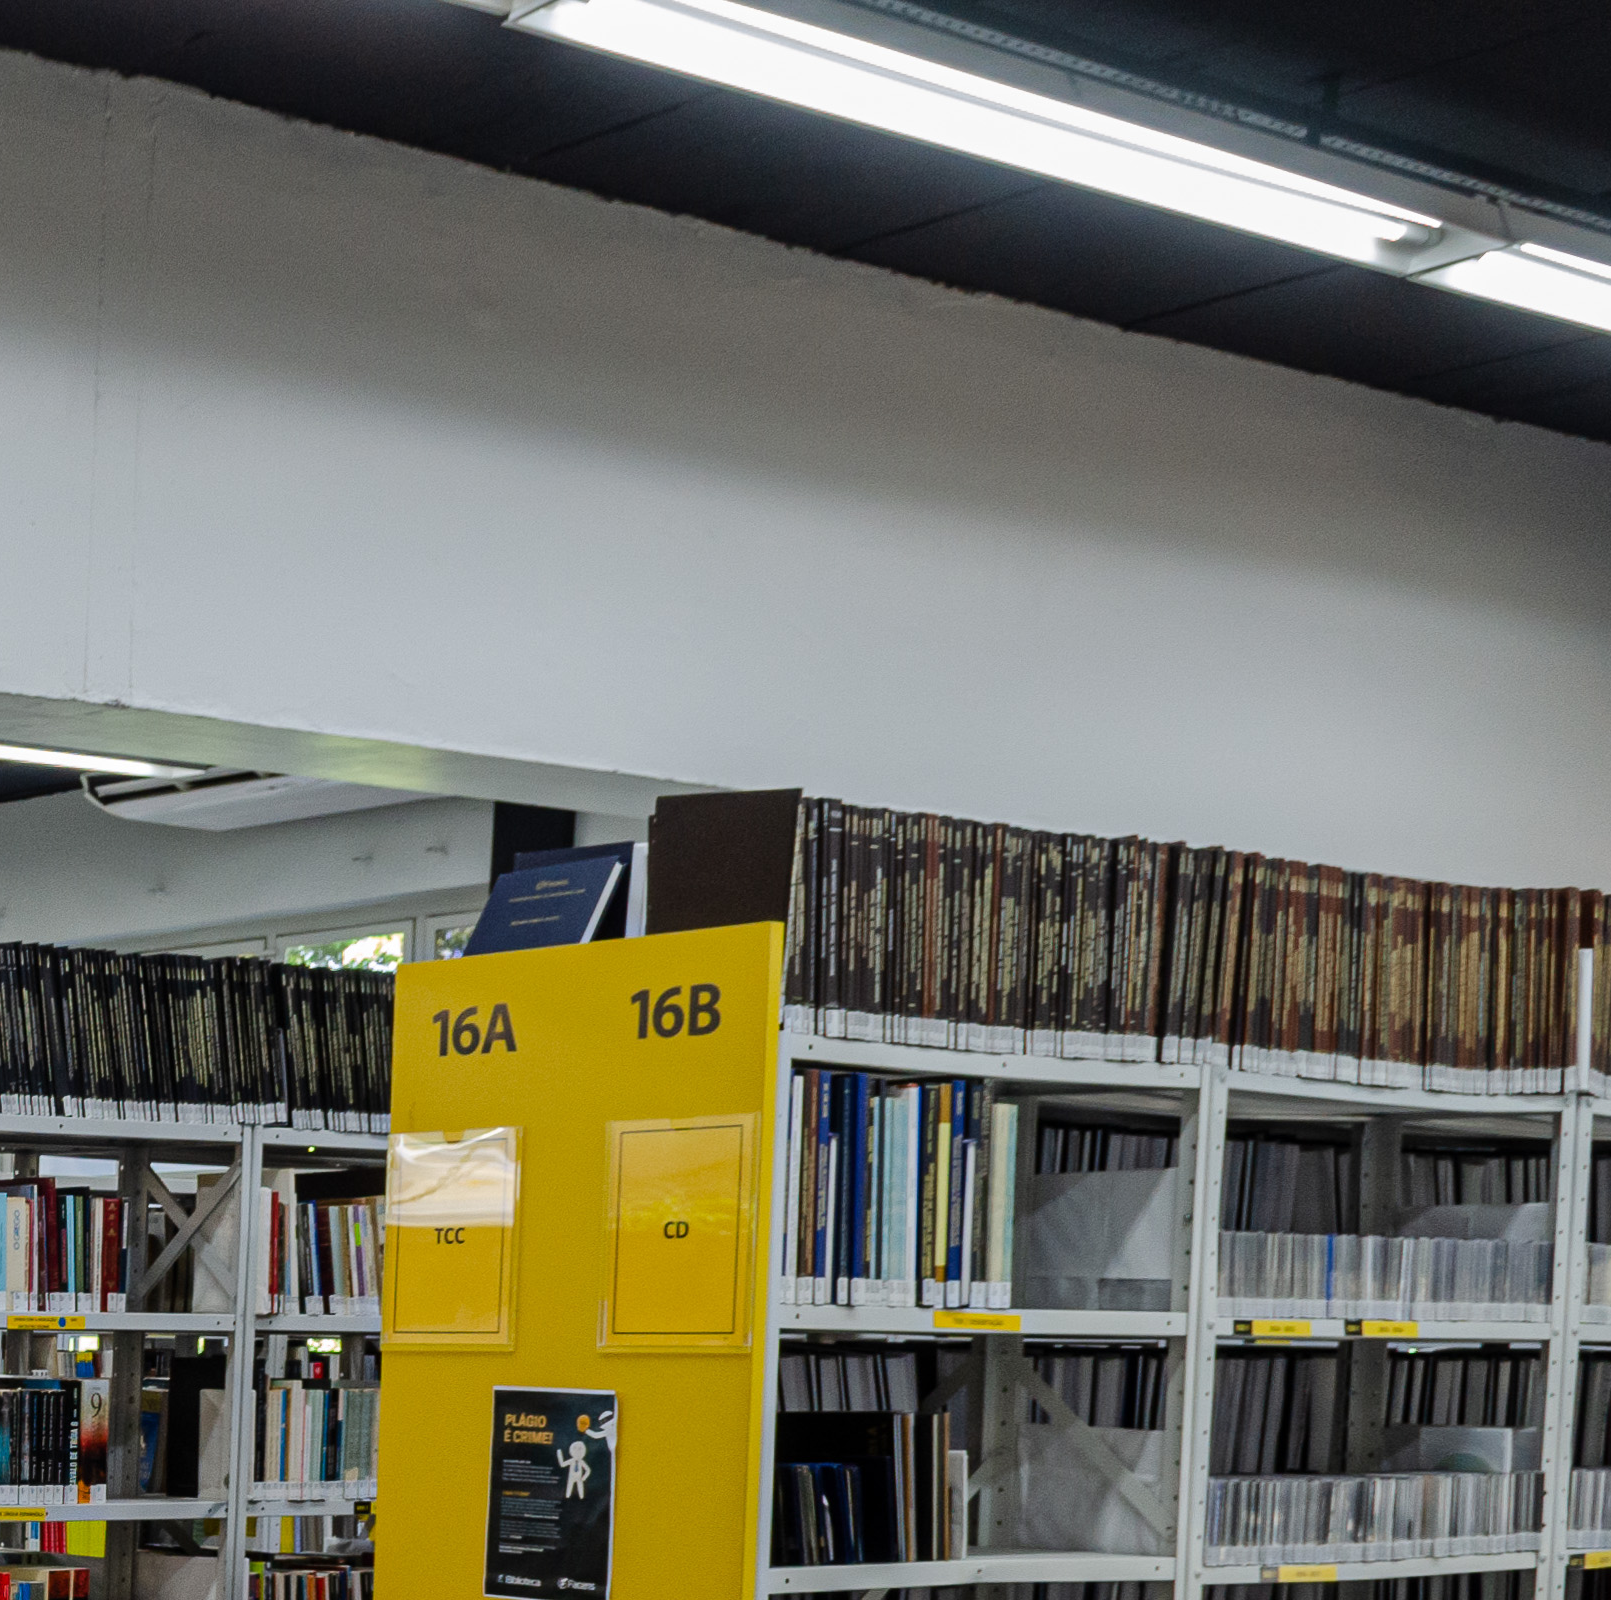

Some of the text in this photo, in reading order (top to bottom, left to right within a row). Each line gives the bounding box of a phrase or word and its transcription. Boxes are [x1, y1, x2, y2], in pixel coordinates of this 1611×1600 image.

[630, 982, 722, 1039] 16B
[433, 1003, 517, 1057] 16A
[435, 1227, 465, 1245] TCC
[663, 1220, 689, 1240] CD
[91, 1392, 103, 1418] 9
[504, 1412, 547, 1428] PLÁGIO
[503, 1429, 553, 1445] É CRIME!
[70, 1451, 78, 1460] DE
[505, 1575, 542, 1587] Biblioteca
[567, 1580, 596, 1591] Facens
